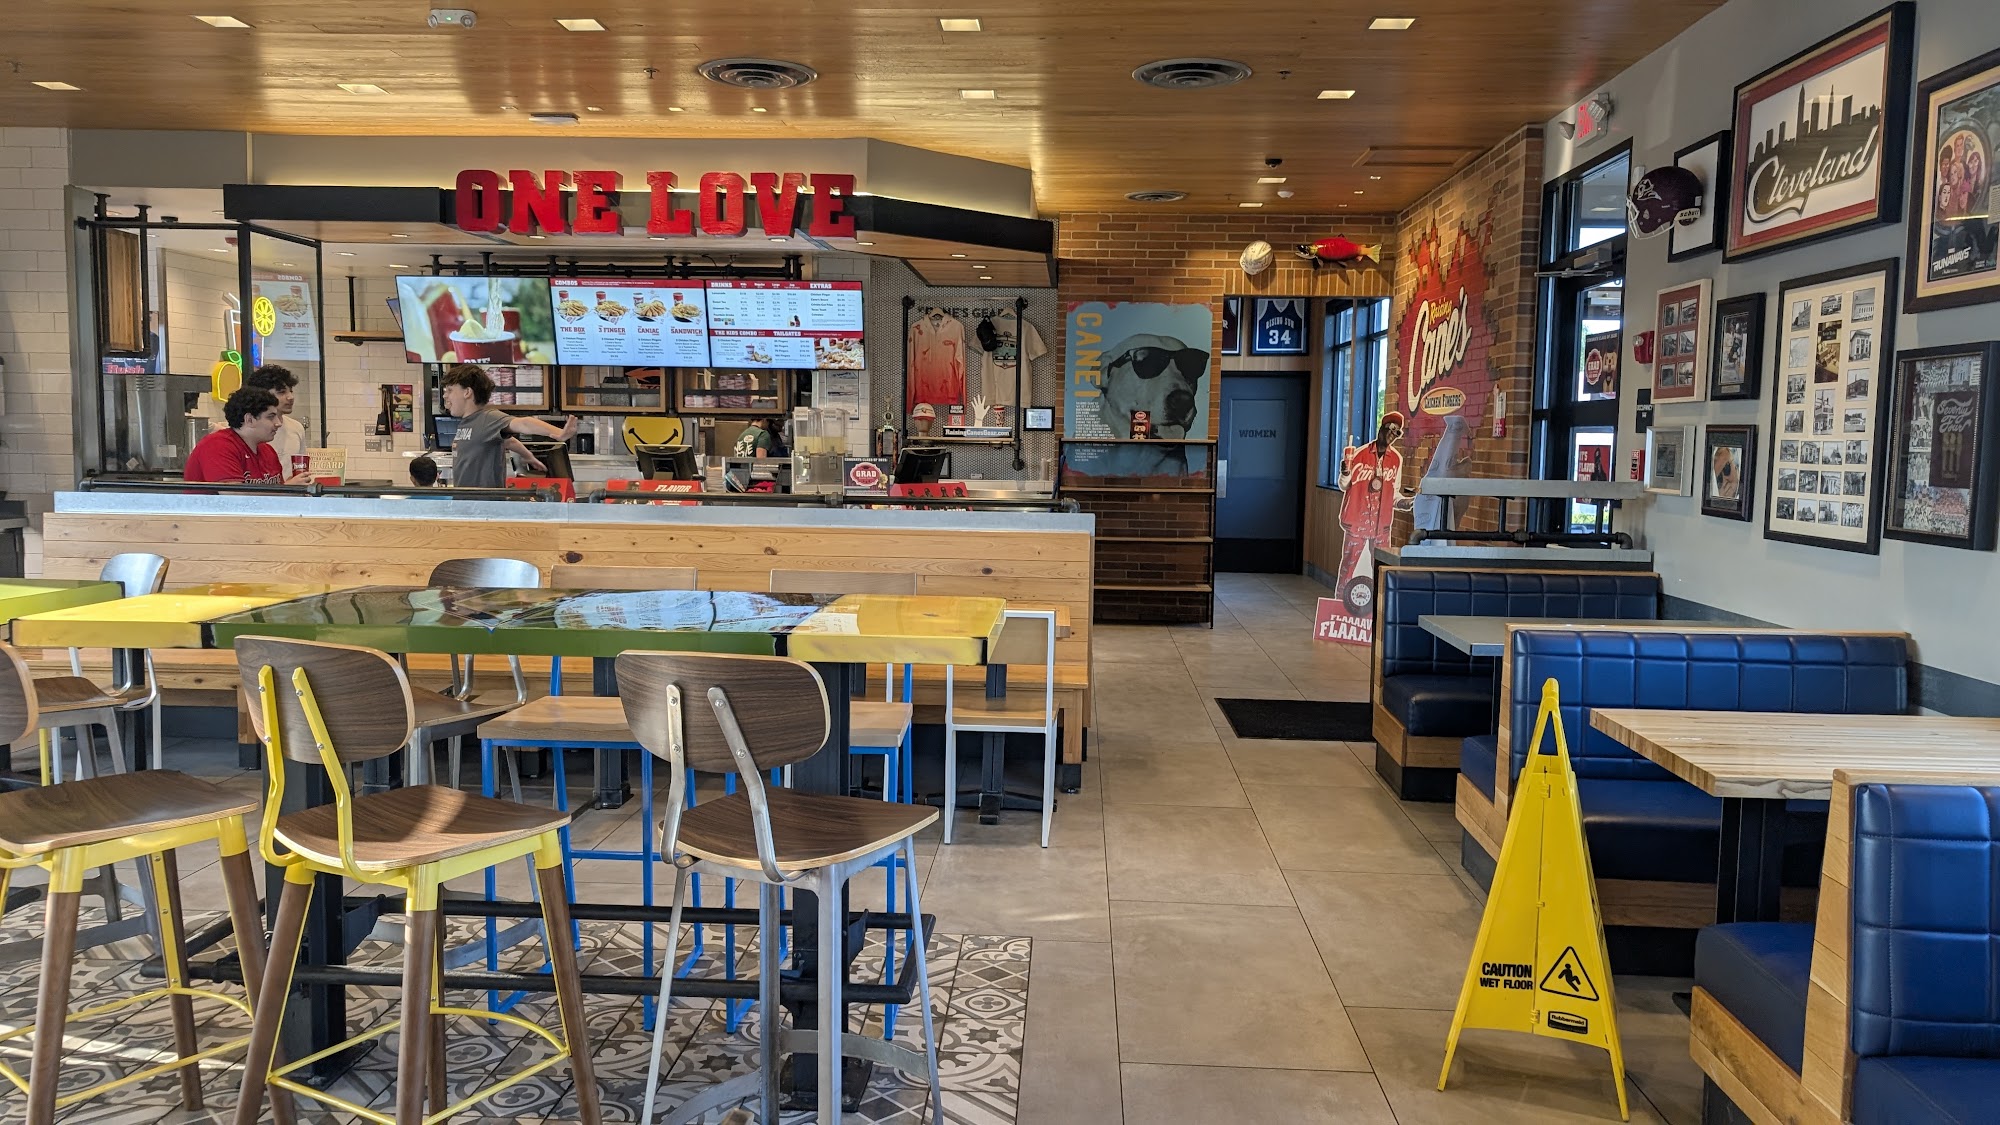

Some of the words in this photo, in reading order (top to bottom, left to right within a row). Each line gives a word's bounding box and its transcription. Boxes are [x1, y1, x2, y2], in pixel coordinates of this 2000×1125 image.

[1748, 125, 1878, 220] Cleveland
[456, 169, 624, 236] ONE
[646, 171, 858, 238] LOVE
[1932, 247, 1971, 272] RUNAWAYS
[1430, 297, 1452, 325] Raising
[1266, 317, 1283, 329] RISING
[1285, 317, 1295, 329] SUN
[1269, 329, 1291, 345] 34
[1074, 312, 1102, 385] CANE
[1408, 286, 1472, 412] Cane's
[1424, 396, 1441, 408] CHICKEN
[1442, 394, 1461, 408] FINGERS
[945, 428, 1010, 437] RaisingCanesGear.com
[1239, 429, 1276, 438] WOMEN
[321, 461, 344, 469] CARD
[855, 470, 877, 478] GRAD
[1482, 962, 1533, 978] CAUTION
[1480, 978, 1500, 988] WET
[1503, 980, 1533, 990] FLOOR
[1552, 1014, 1585, 1026] Rubbermaid
